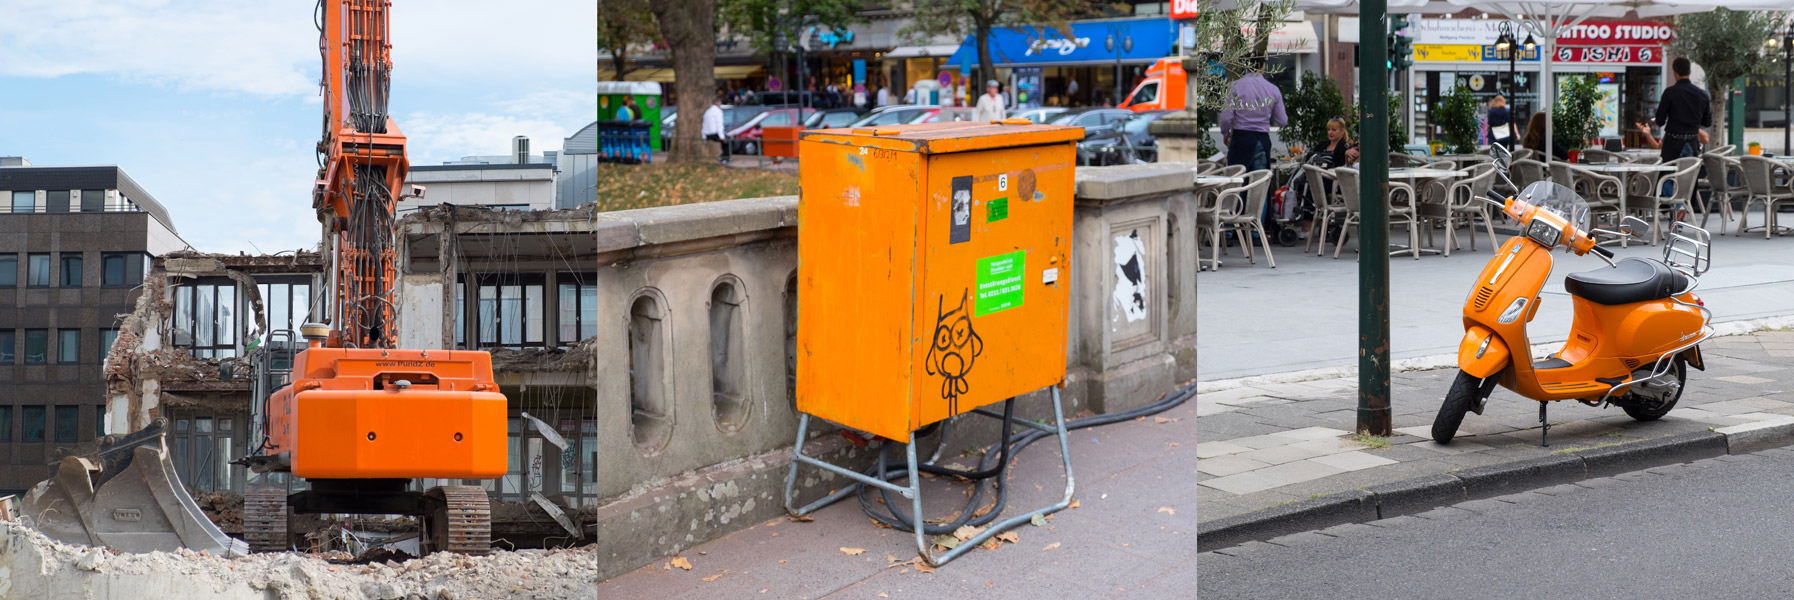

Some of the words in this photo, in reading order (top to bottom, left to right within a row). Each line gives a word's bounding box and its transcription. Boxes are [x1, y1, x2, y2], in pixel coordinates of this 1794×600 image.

[1615, 25, 1671, 40] STUDIO
[859, 146, 869, 156] 24
[1000, 176, 1006, 189] 6
